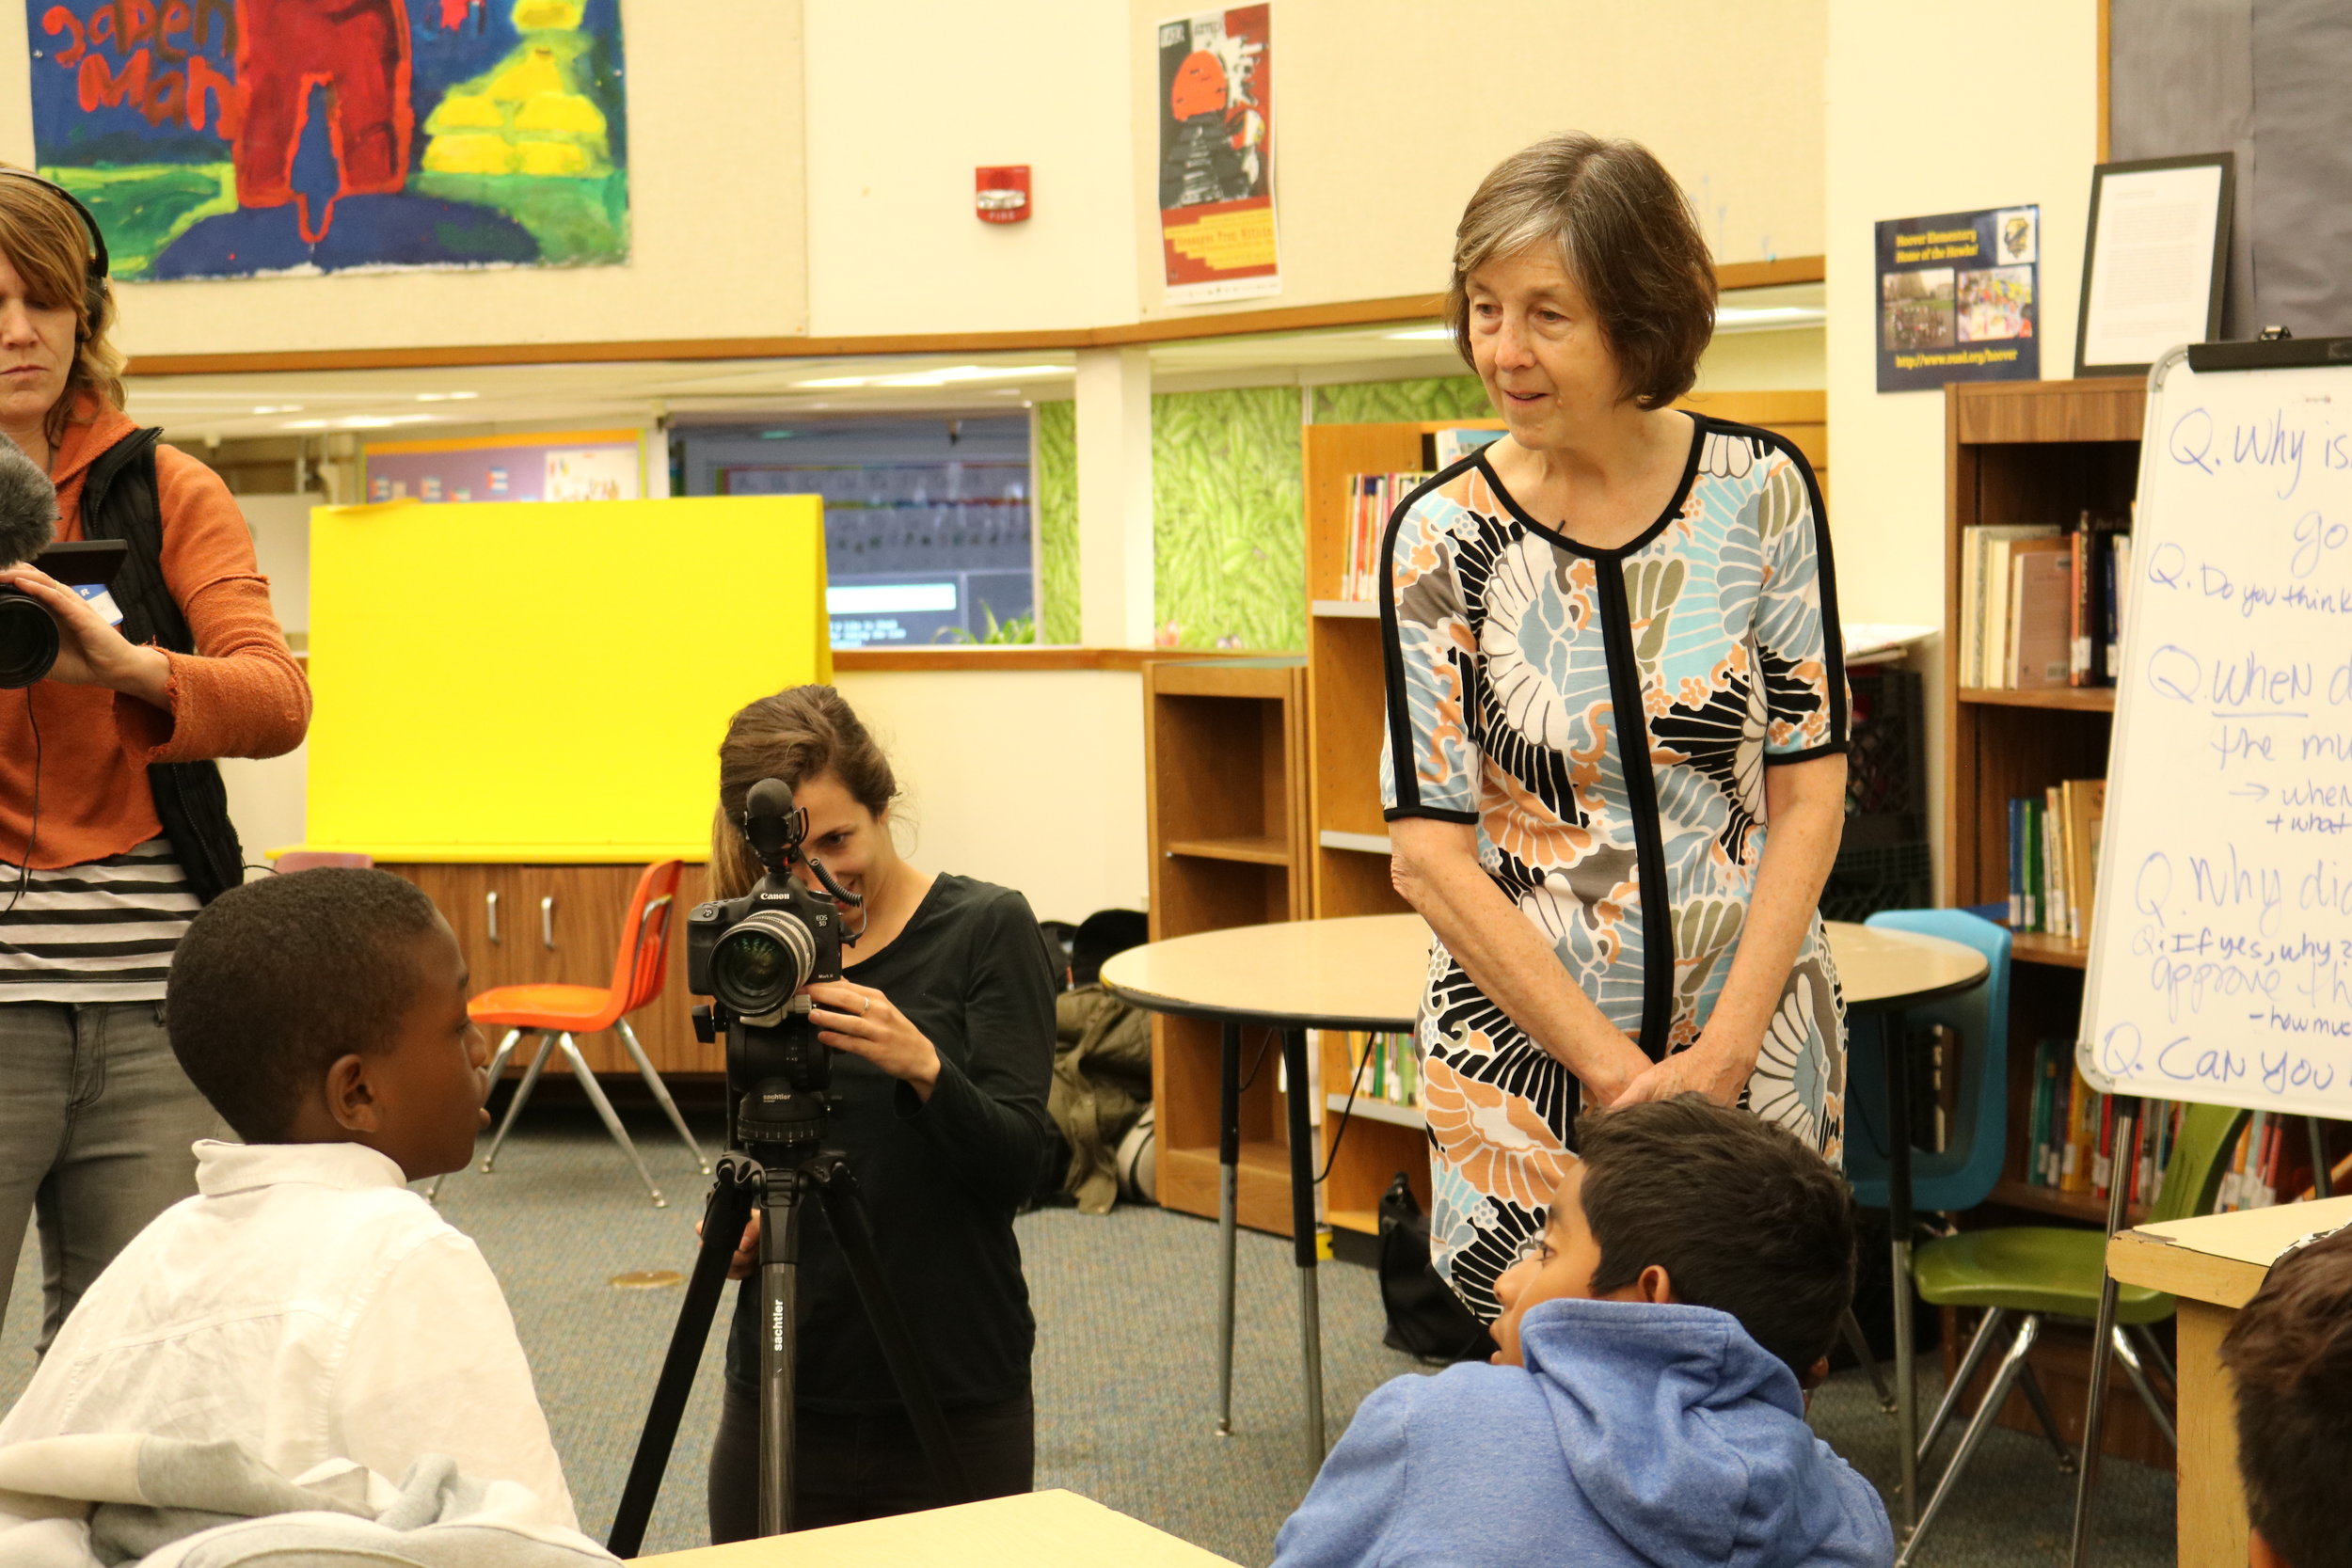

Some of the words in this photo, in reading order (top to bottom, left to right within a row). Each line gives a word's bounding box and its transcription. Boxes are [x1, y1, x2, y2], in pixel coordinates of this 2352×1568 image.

[78, 48, 246, 140] Man
[1895, 249, 1919, 263] Home
[1896, 234, 1926, 248] Hoover
[1927, 229, 1978, 245] Elementary
[2233, 408, 2306, 500] Why
[2201, 562, 2234, 600] Do
[2242, 583, 2277, 618] you
[2211, 724, 2276, 770] the
[2290, 812, 2352, 834] what
[773, 1299, 784, 1352] sachtler
